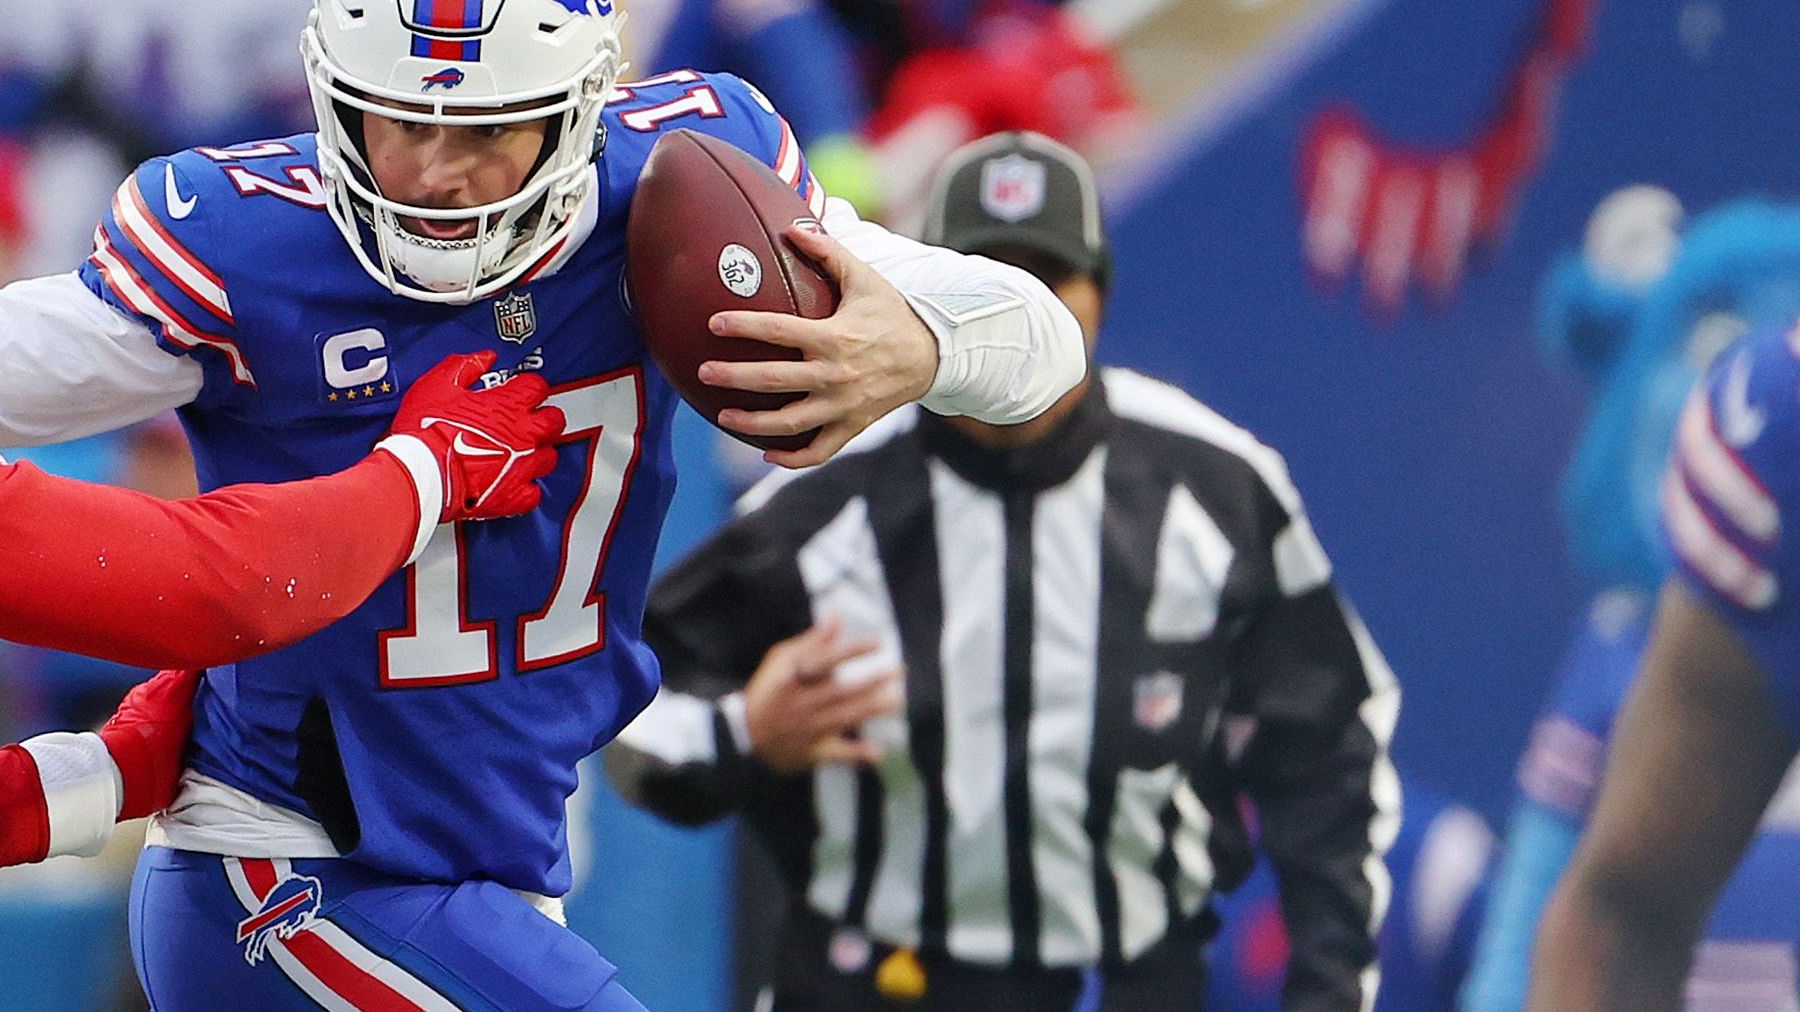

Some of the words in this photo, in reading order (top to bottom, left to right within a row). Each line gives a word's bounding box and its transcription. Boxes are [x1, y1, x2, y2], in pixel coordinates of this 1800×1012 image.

[191, 142, 327, 210] 17
[721, 259, 745, 288] 362
[502, 314, 531, 336] NFL
[321, 327, 389, 390] C
[376, 366, 647, 689] 17
